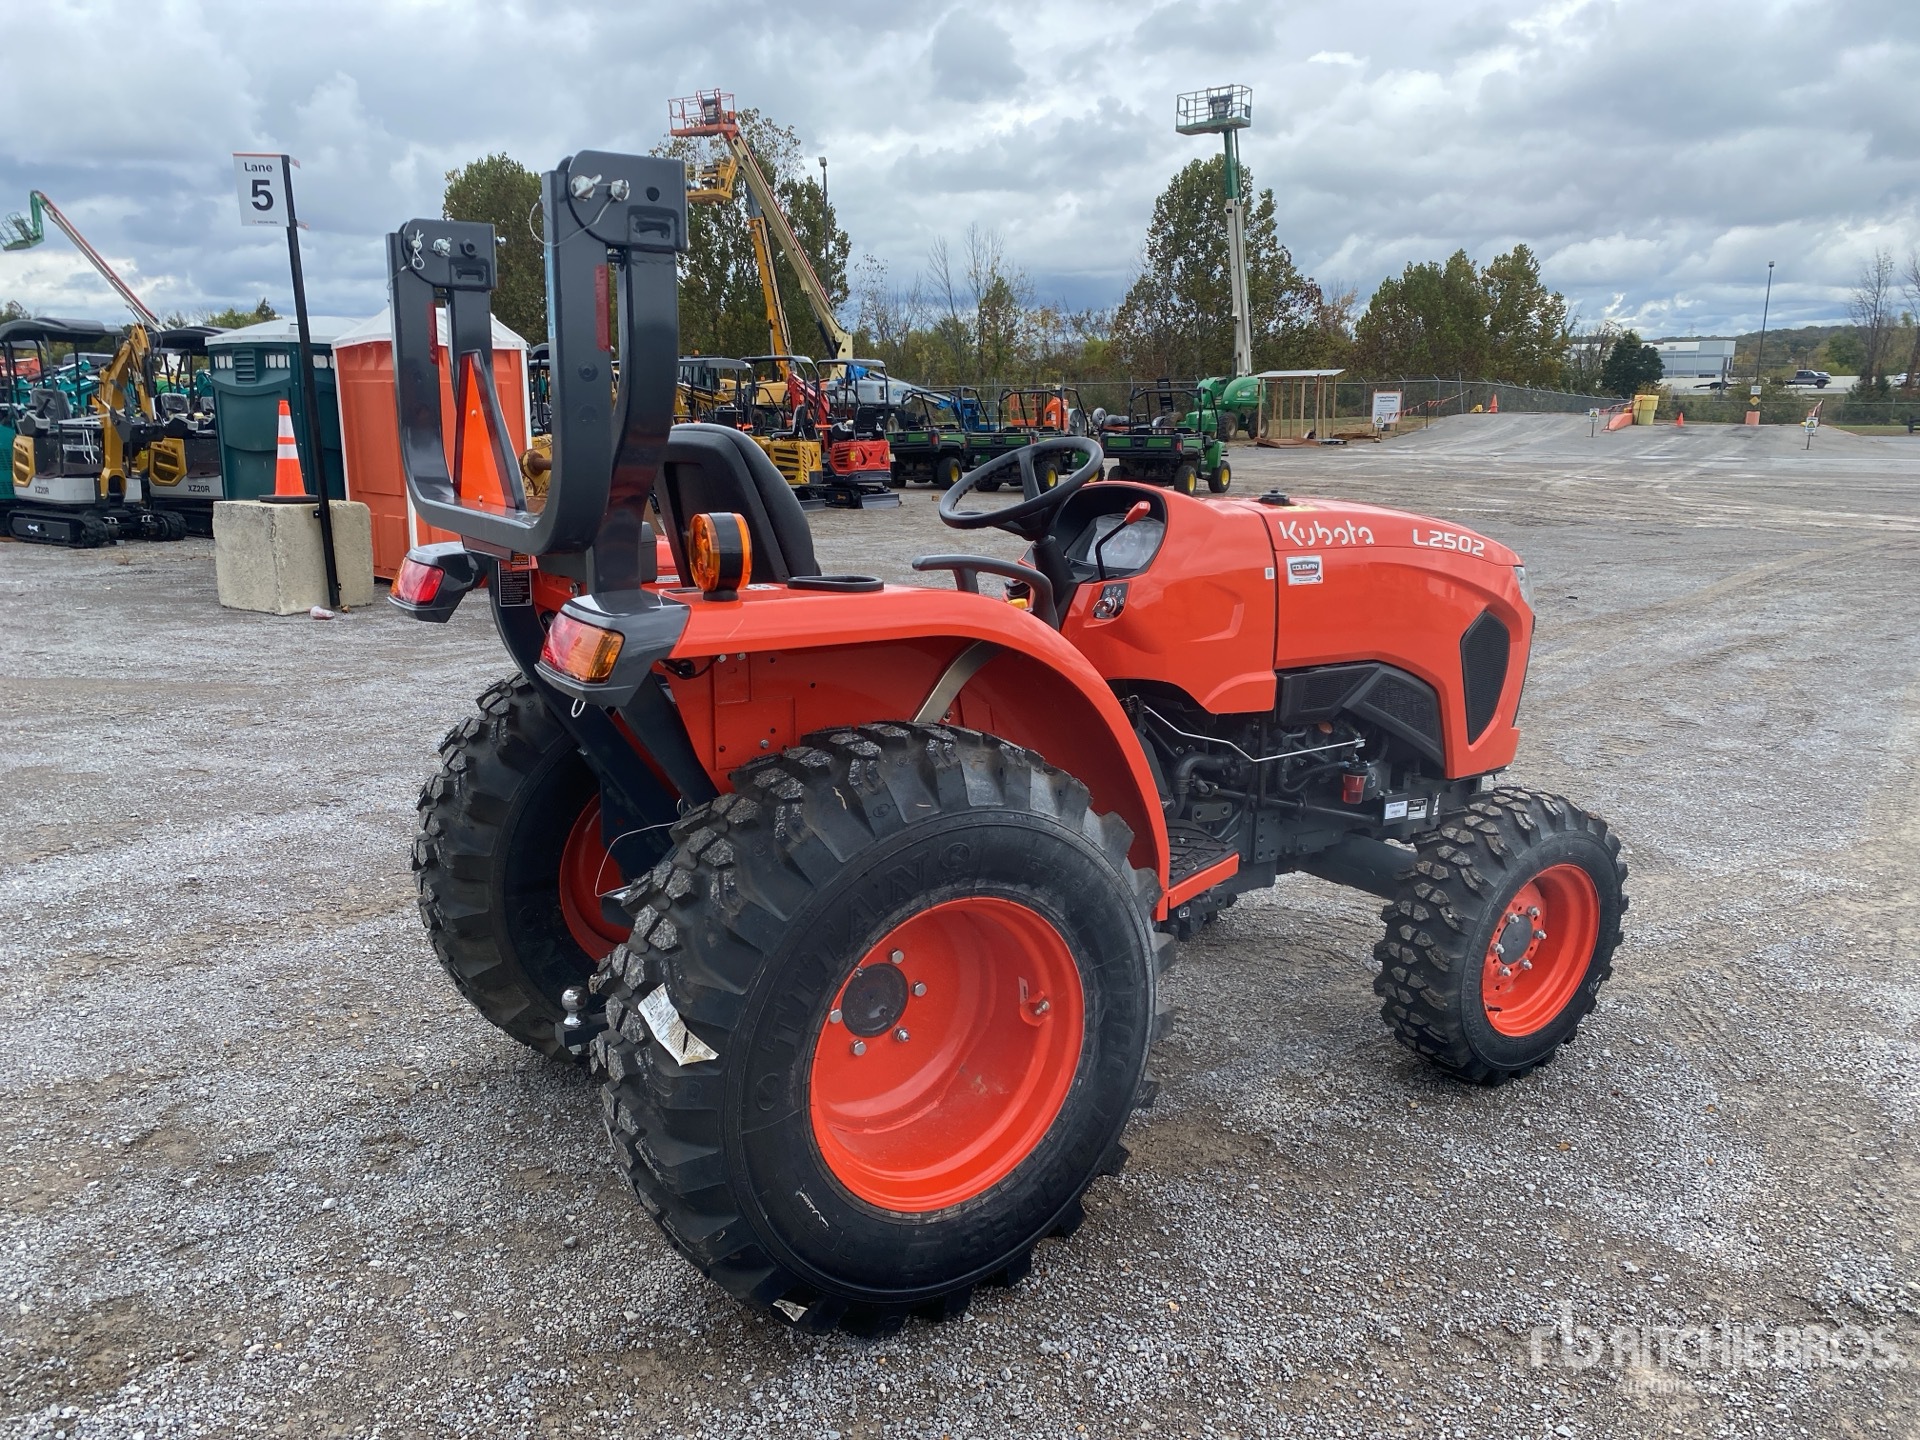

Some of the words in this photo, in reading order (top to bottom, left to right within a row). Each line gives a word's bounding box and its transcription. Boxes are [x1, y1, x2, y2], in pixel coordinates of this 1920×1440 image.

[244, 161, 273, 173] Lane
[251, 179, 274, 212] 5
[35, 485, 50, 495] XZ20R
[188, 484, 211, 494] XZ20R
[1278, 520, 1375, 547] Kubota
[1412, 528, 1486, 558] L2502
